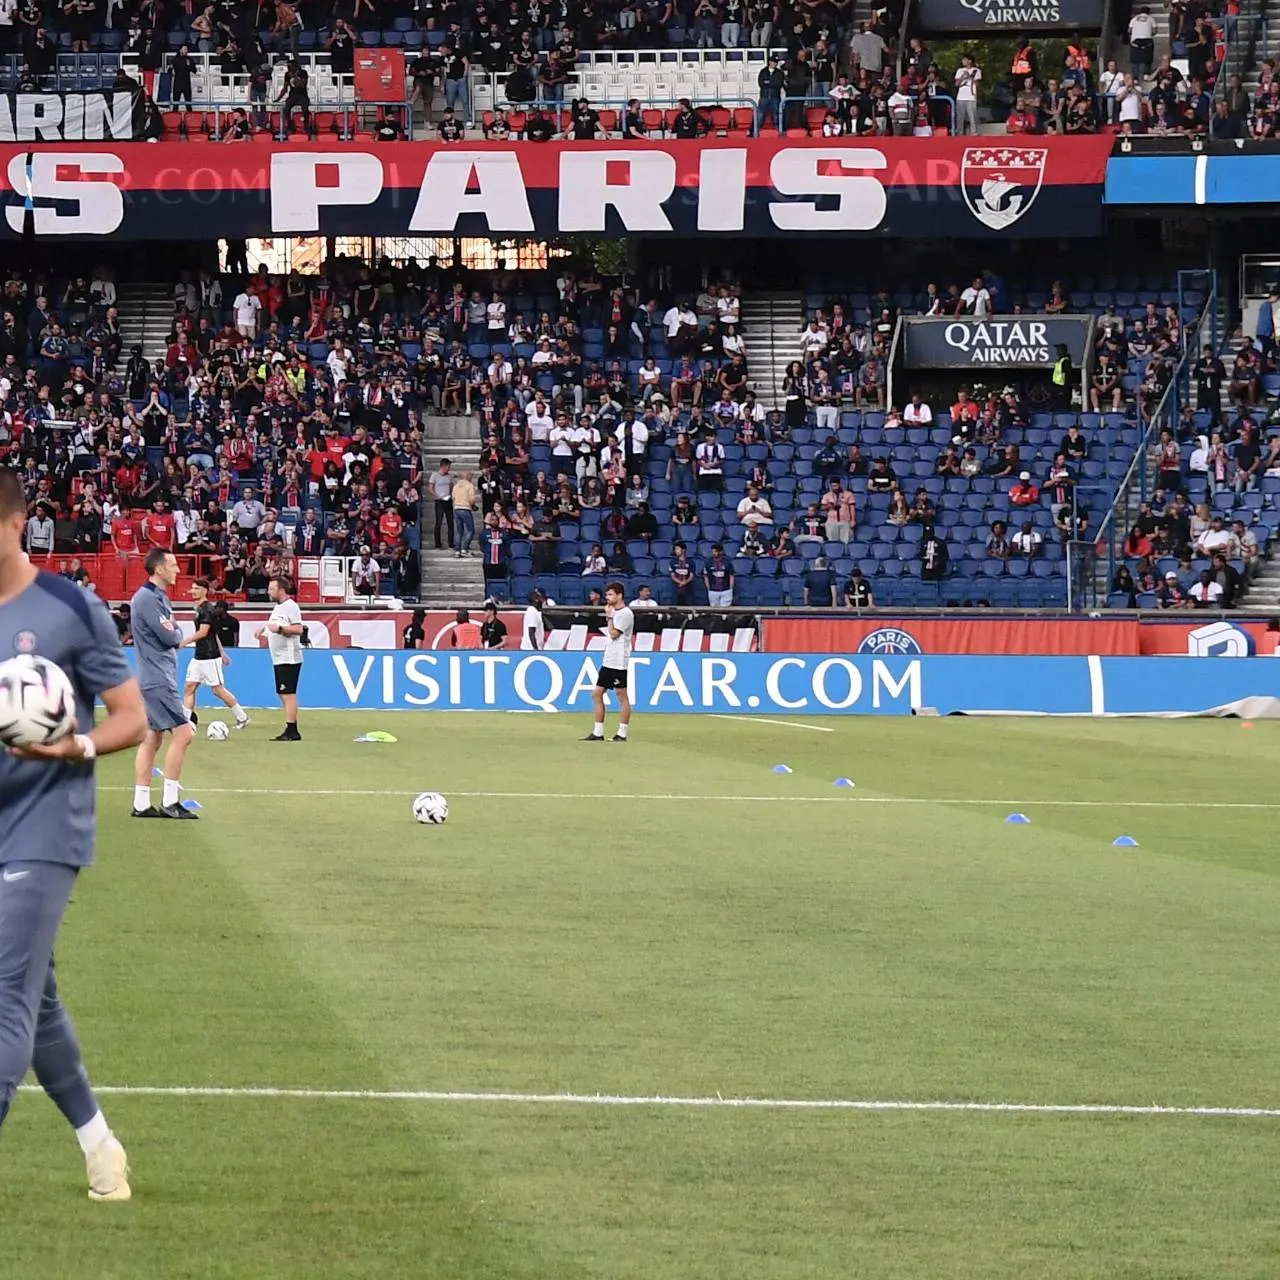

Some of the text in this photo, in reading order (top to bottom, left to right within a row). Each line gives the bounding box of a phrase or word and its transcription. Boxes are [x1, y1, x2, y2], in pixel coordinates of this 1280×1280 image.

[984, 7, 1060, 24] AIRWAYS
[270, 146, 888, 232] PARIS
[944, 322, 1049, 351] QATAR
[971, 347, 1050, 362] AIRWAYS
[866, 632, 911, 649] PARIS
